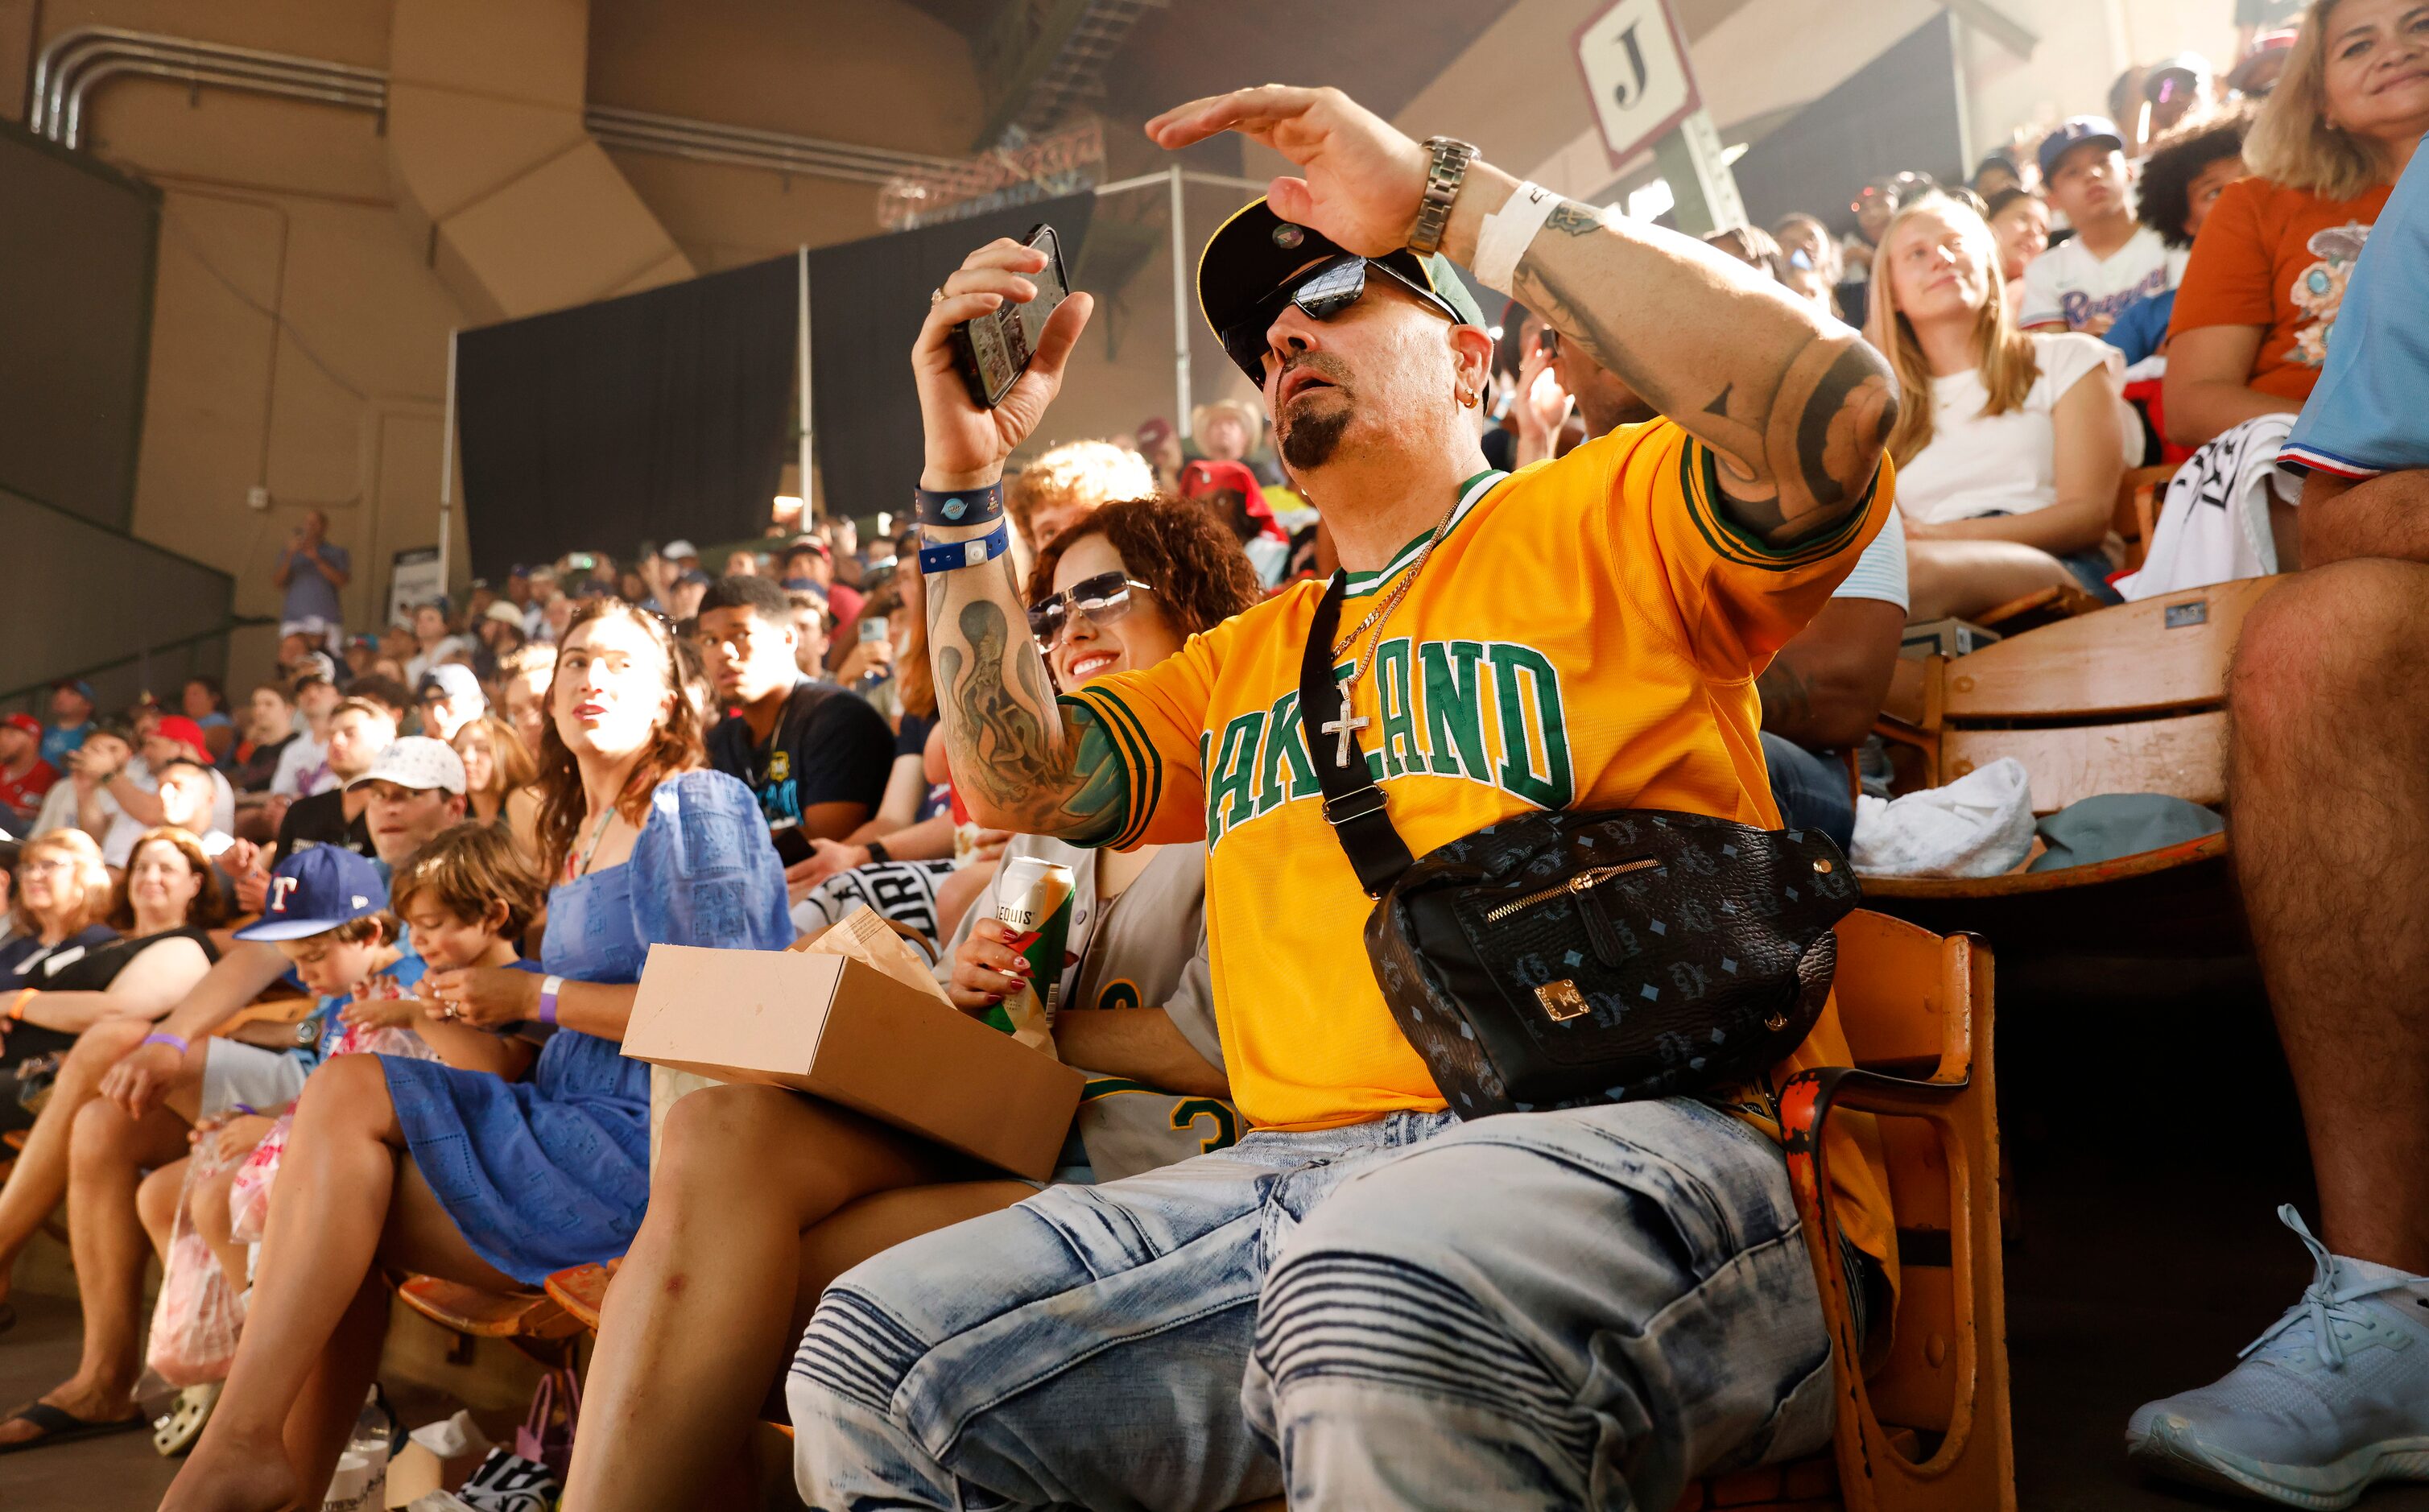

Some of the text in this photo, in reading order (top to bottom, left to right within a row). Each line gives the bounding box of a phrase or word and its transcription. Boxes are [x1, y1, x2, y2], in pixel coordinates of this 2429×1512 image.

[1613, 18, 1649, 110] J
[1200, 636, 1575, 857] AKAND
[271, 874, 299, 913] T
